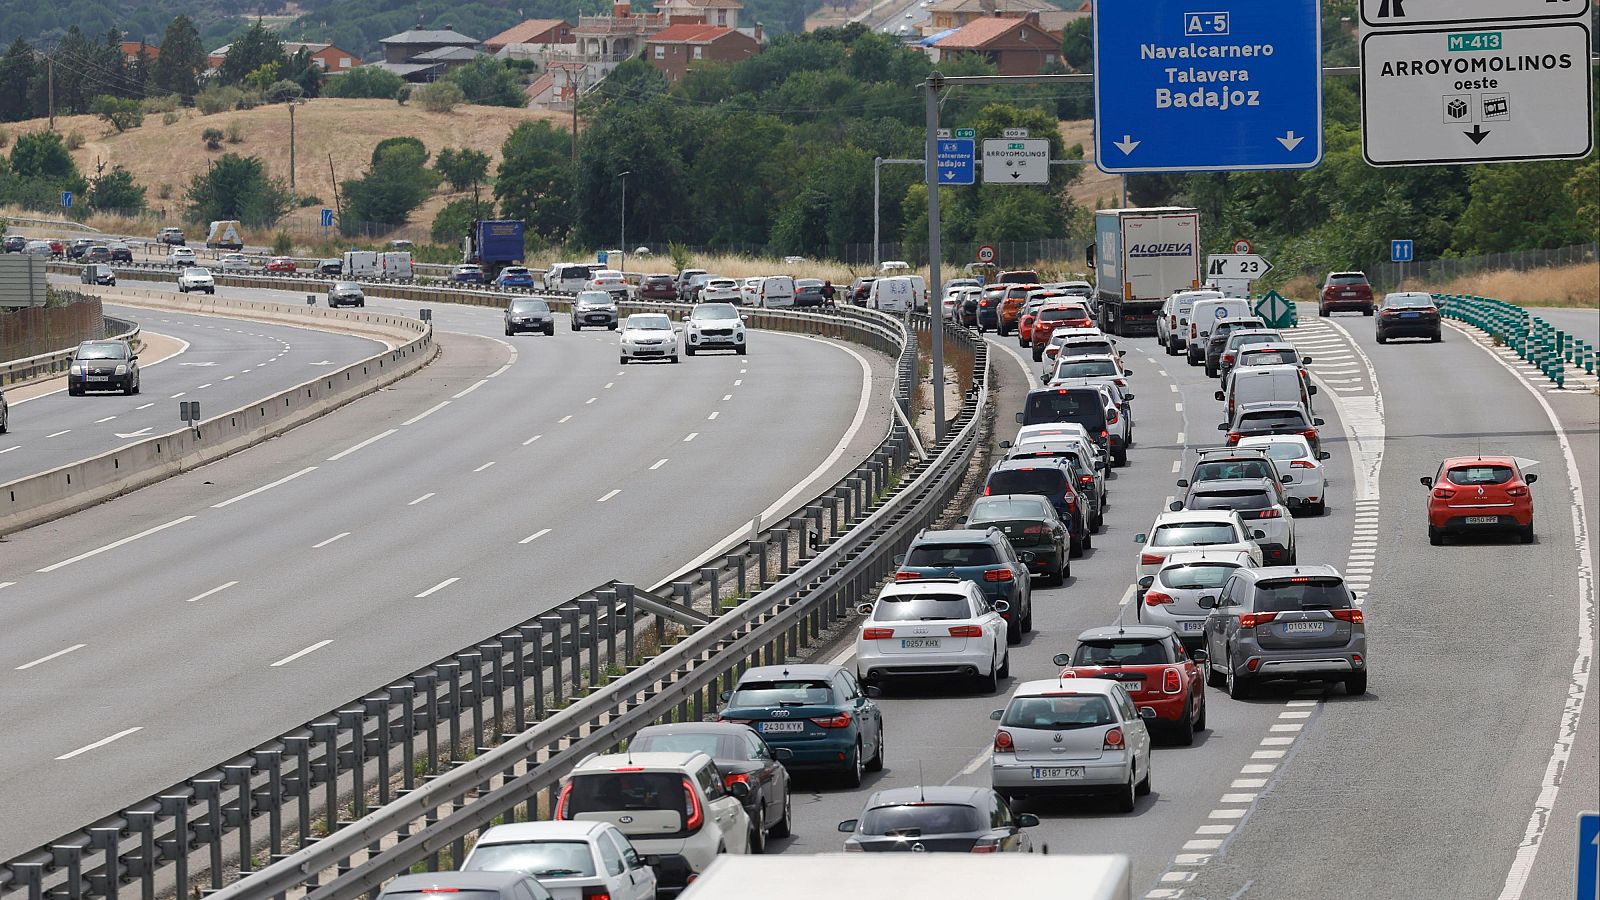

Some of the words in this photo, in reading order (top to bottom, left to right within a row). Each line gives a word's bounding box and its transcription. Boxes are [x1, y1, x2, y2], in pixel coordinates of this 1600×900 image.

[1188, 15, 1226, 32] A-5
[1450, 35, 1500, 49] M-413
[1140, 43, 1274, 59] Navalcarnero
[1381, 54, 1572, 76] ARROYOMOLINOS
[1165, 68, 1249, 83] Talavera
[1454, 77, 1498, 90] oeste
[1155, 86, 1260, 110] Badajoz
[937, 160, 966, 168] adajoz
[1129, 243, 1192, 253] ALQUEVA
[981, 250, 992, 258] 80
[1240, 262, 1258, 273] 23
[1288, 622, 1307, 630] 0103
[1308, 621, 1322, 629] KVZ
[906, 640, 923, 648] 0257
[926, 640, 939, 648] KHX
[763, 722, 784, 731] 2430
[786, 722, 802, 731] KYK
[1042, 769, 1061, 777] 6187
[1065, 769, 1080, 777] FCK
